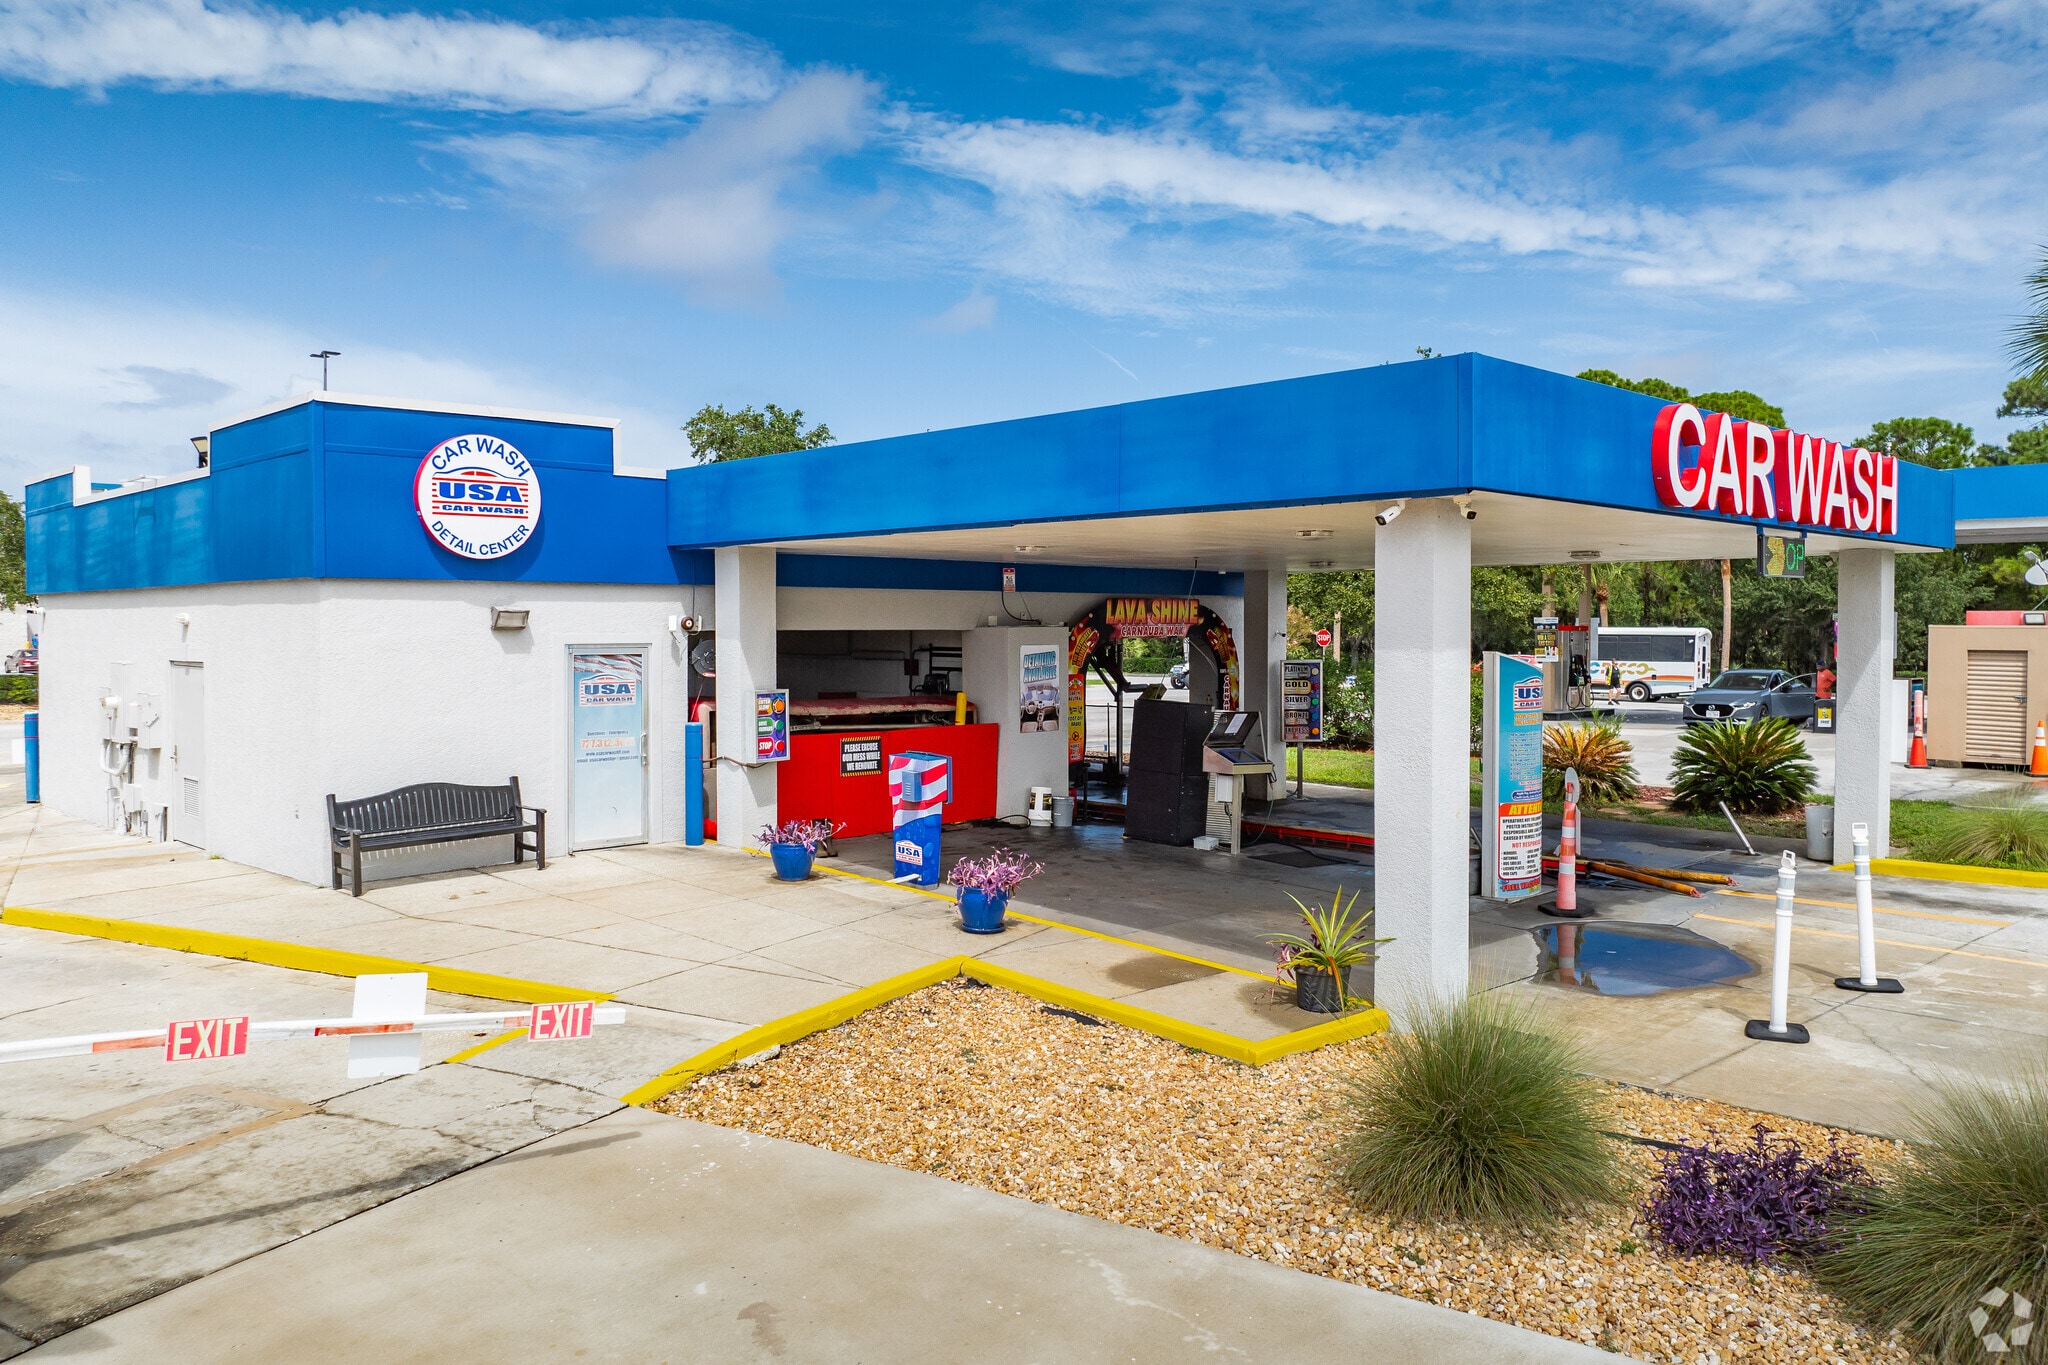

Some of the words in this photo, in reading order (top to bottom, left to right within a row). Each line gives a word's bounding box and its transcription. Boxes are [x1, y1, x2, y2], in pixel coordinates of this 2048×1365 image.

[432, 439, 472, 470] CAR
[476, 437, 530, 477] WASH
[1660, 403, 1775, 518] CAR
[1778, 429, 1898, 536] WASH
[439, 482, 522, 502] USA
[478, 506, 524, 514] WASH
[432, 520, 476, 555] DETAIL
[479, 524, 530, 556] CENTER
[1106, 598, 1148, 624] LAVA
[1150, 599, 1200, 625] SHINE
[1120, 624, 1164, 636] CARNAUBA
[1166, 625, 1185, 636] WAX
[1023, 651, 1056, 668] DETAILING
[1284, 664, 1308, 672] PLATINUM
[1023, 666, 1056, 684] AVAILABLE
[584, 684, 631, 695] USA
[759, 742, 772, 750] STOP
[844, 744, 861, 752] PLEASE
[862, 742, 878, 751] EXCUSE
[842, 753, 852, 762] OUR
[853, 752, 866, 761] MESS
[866, 752, 880, 760] WHILE
[847, 763, 855, 771] WE
[855, 761, 878, 770] RENOVATE
[898, 846, 920, 858] USA
[1502, 884, 1519, 892] FREE
[534, 1004, 589, 1039] EXIT
[172, 1017, 244, 1060] EXIT
